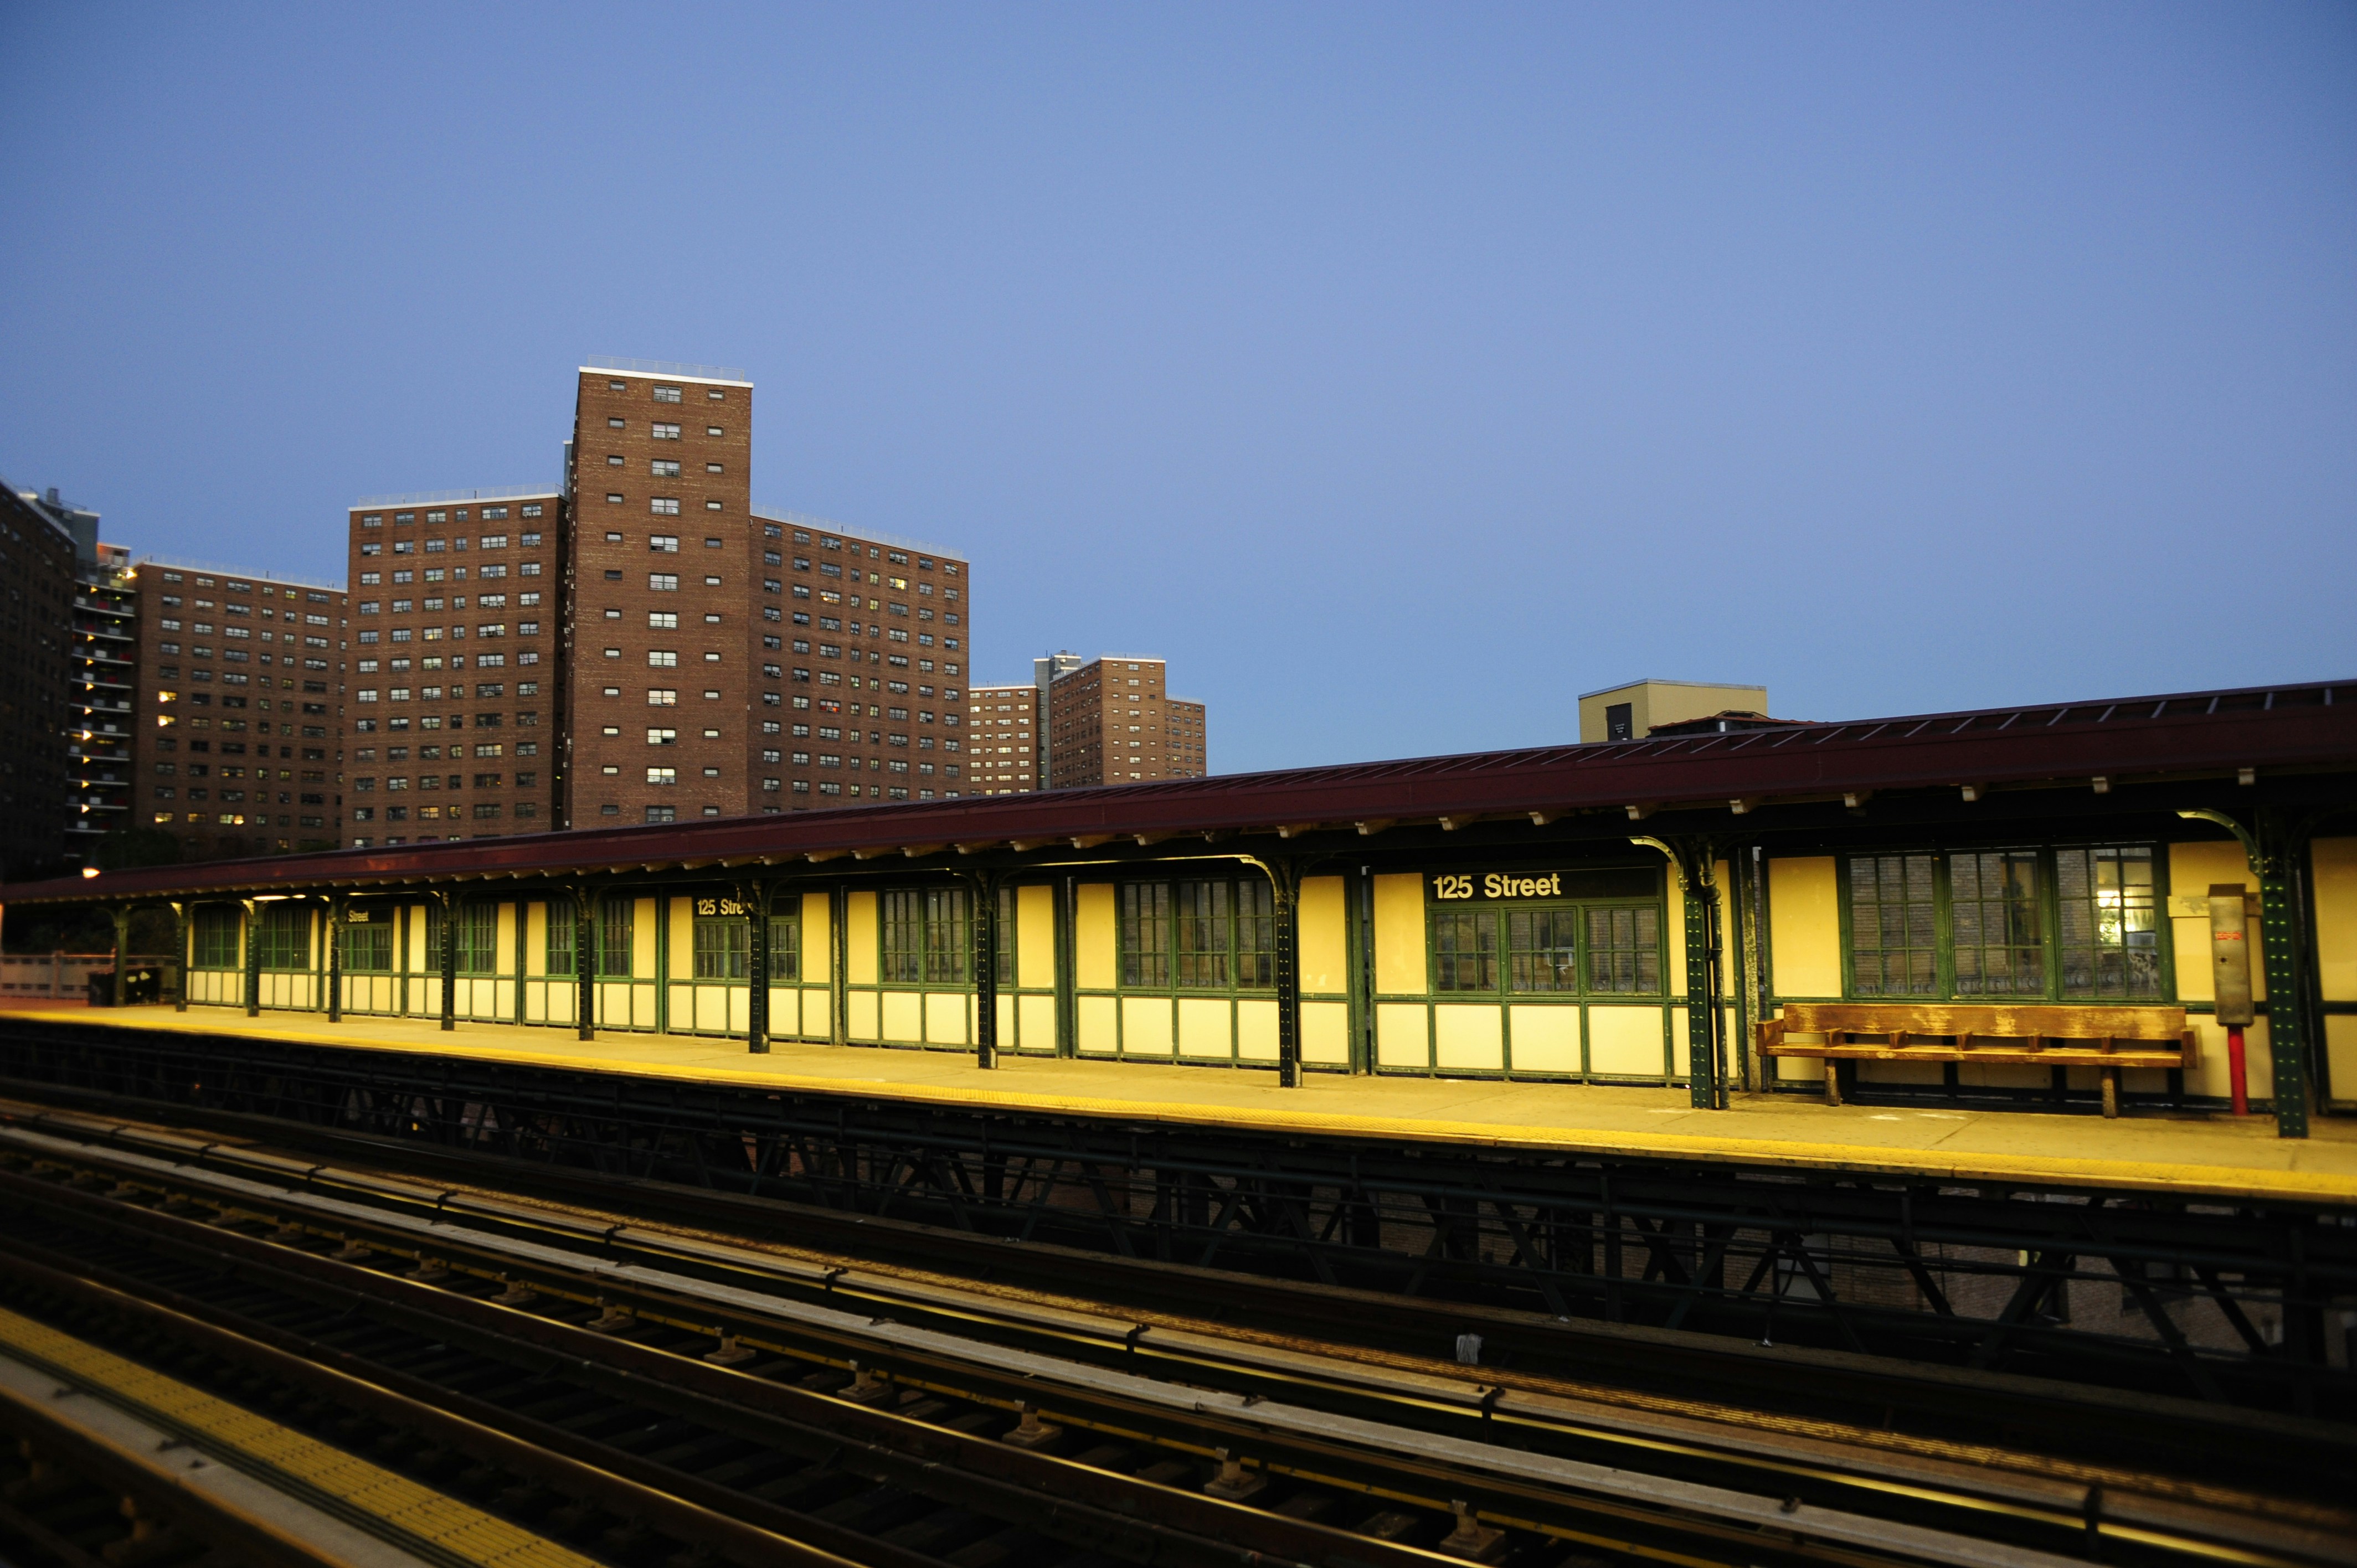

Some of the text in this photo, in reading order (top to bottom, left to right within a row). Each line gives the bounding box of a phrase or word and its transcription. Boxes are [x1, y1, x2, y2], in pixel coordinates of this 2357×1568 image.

[1433, 873, 1561, 899] 125 Street
[697, 898, 753, 915] 125 Stre
